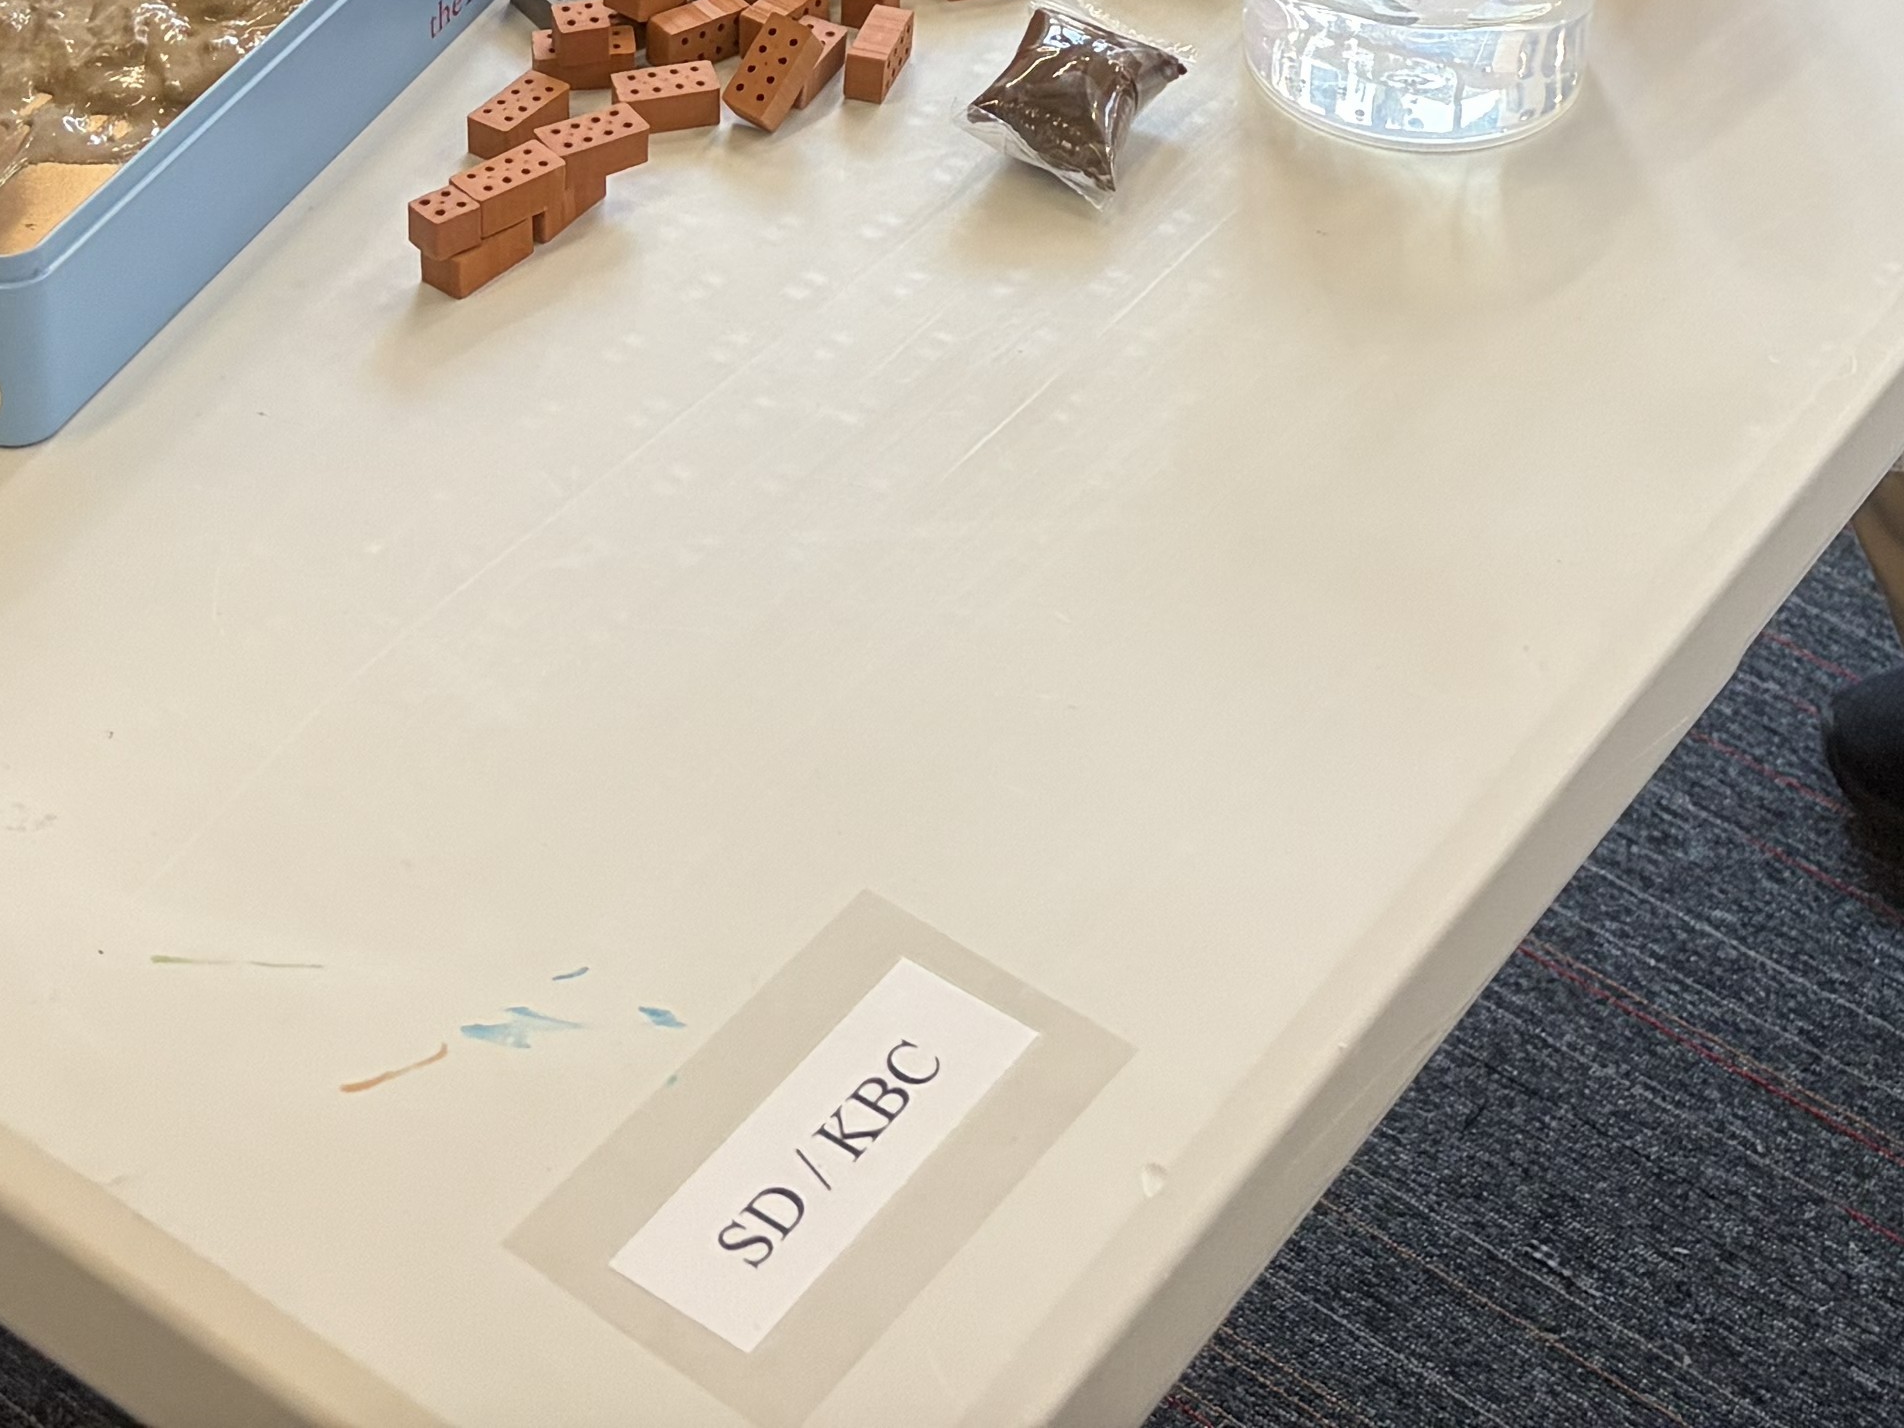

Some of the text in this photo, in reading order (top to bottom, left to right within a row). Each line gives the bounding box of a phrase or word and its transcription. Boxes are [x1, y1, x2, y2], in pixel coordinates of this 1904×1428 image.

[717, 1038, 941, 1269] SD / KBC
